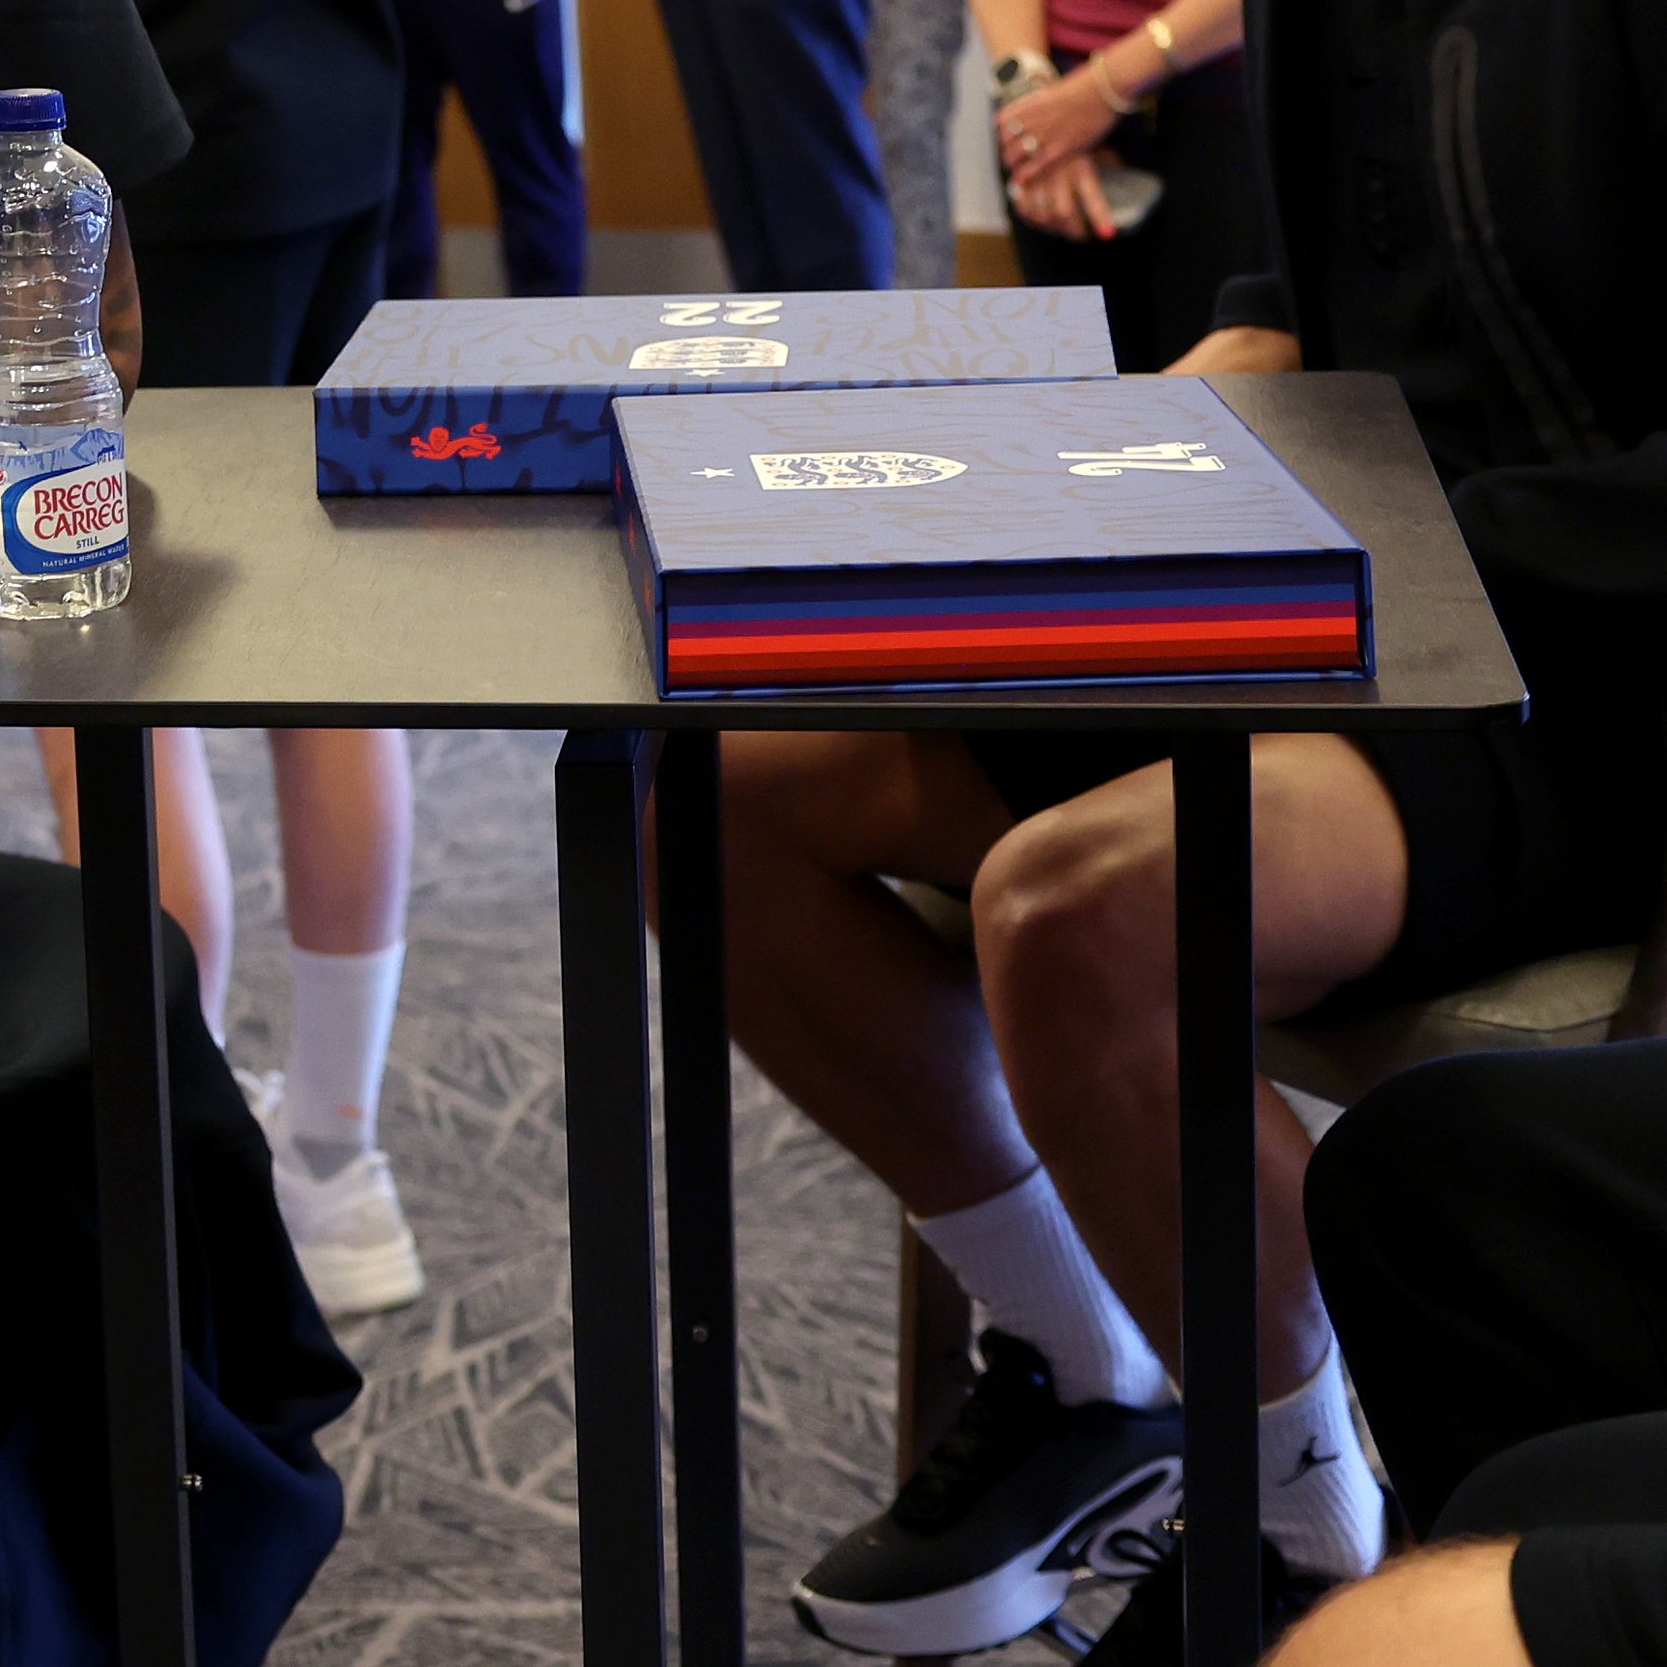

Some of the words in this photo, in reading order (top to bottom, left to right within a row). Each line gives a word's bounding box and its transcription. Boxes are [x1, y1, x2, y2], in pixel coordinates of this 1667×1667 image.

[659, 299, 783, 326] 22
[33, 472, 123, 516] BRECON
[33, 499, 125, 540] CARREG
[75, 535, 100, 549] STILL
[42, 556, 77, 568] NATURAL
[78, 550, 107, 563] MINERAL
